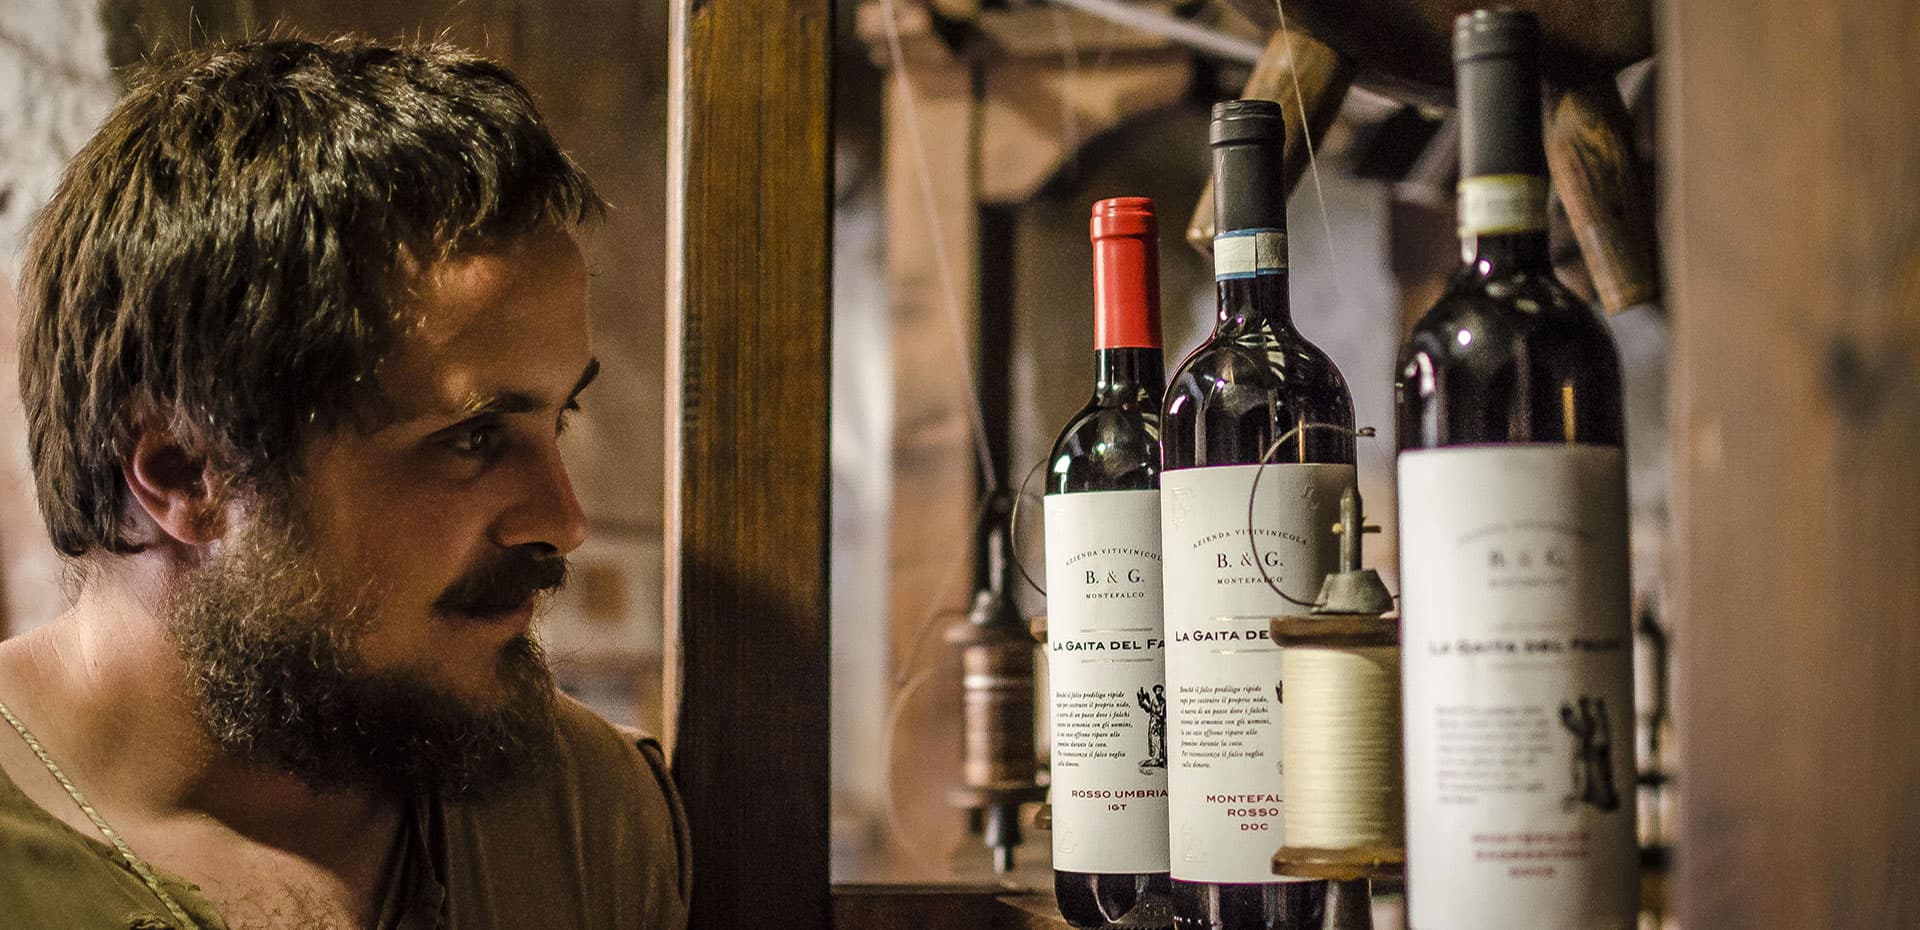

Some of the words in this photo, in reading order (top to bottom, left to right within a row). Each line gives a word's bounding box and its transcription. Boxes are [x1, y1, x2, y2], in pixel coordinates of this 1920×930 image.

[1193, 531, 1230, 549] AZIENDA
[1101, 548, 1162, 561] VITIVINICOL
[1217, 553, 1232, 568] B.
[1241, 553, 1252, 567] &
[1265, 552, 1284, 567] G.
[1086, 570, 1099, 584] B.
[1107, 571, 1117, 584] &
[1127, 568, 1145, 583] G.
[1176, 631, 1190, 642] LA
[1193, 630, 1240, 641] GAITA
[1245, 631, 1269, 641] DE
[1053, 641, 1063, 651] LA
[1066, 641, 1105, 651] GAITA
[1110, 641, 1142, 650] DEL
[1072, 790, 1111, 798] ROSSO
[1114, 789, 1168, 799] UMBRIA
[1206, 794, 1283, 803] MONTEFAL
[1227, 808, 1279, 817] ROSSO
[1240, 823, 1269, 831] DOC
